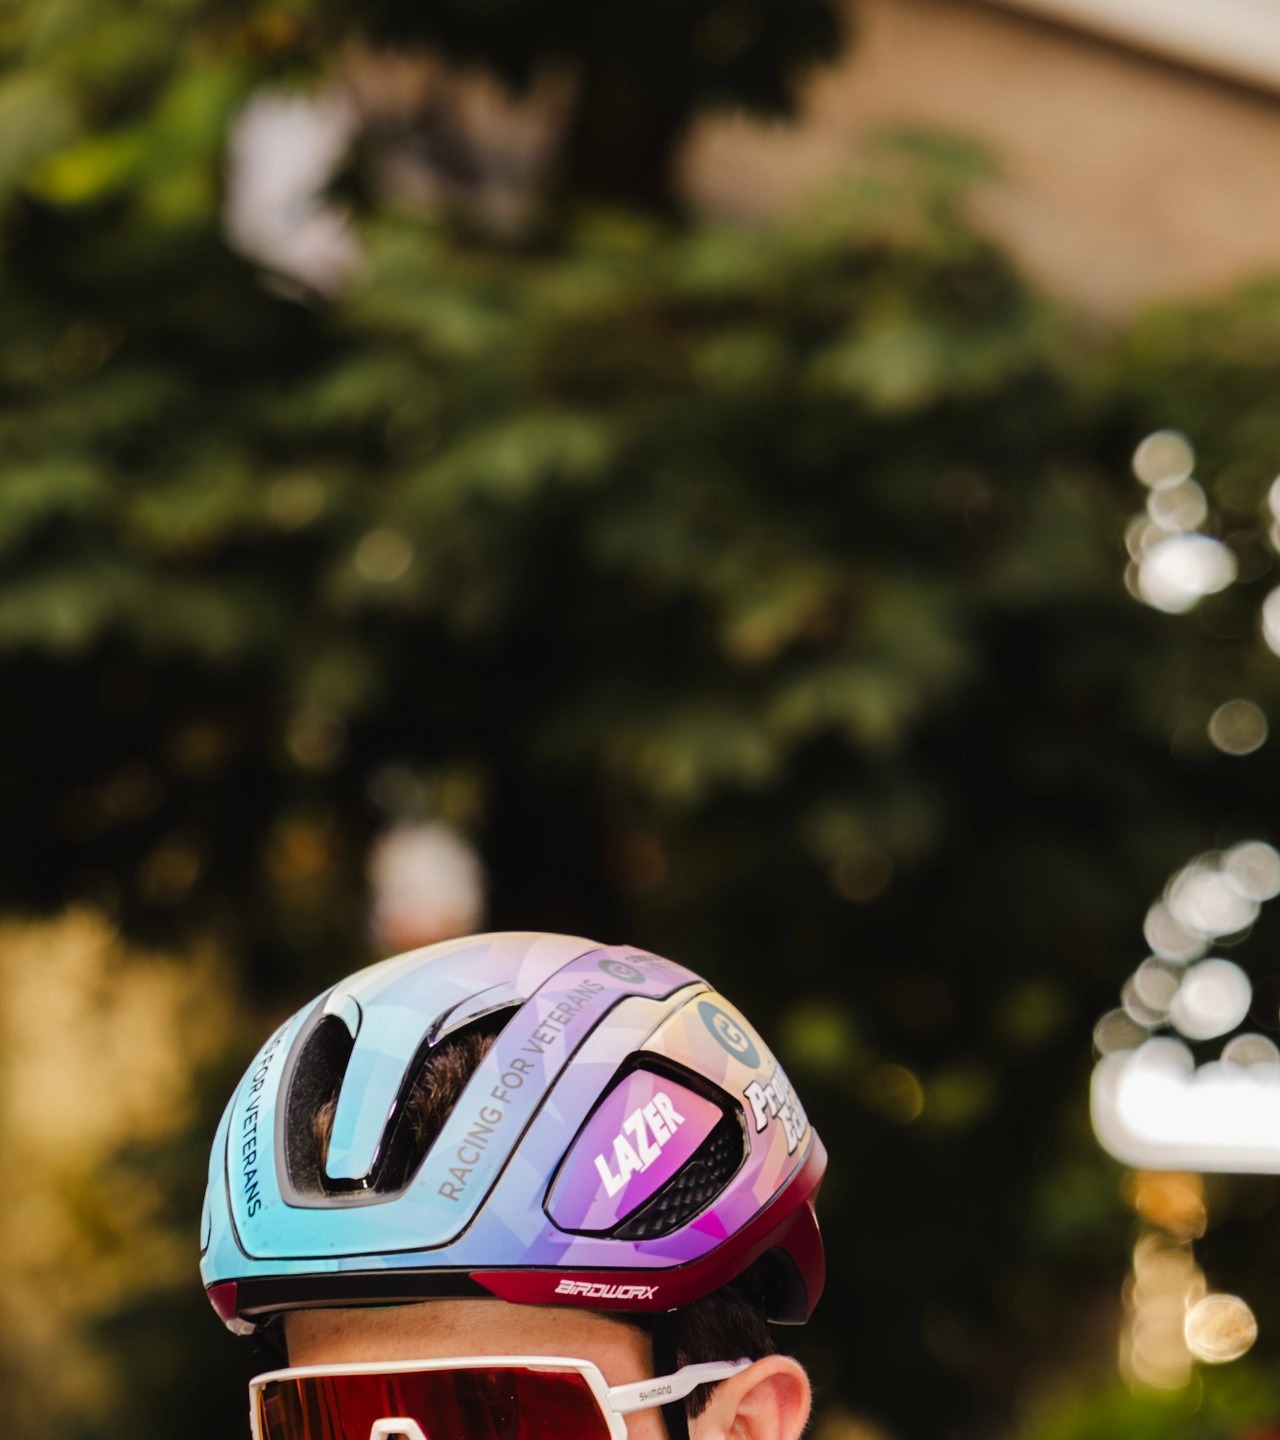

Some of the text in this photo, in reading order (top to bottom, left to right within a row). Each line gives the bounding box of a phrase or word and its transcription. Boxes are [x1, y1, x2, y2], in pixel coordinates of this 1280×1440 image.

[251, 1054, 274, 1097] FOR
[438, 979, 605, 1201] RACING FOR VETERANS
[242, 1095, 264, 1218] VETERANS
[594, 1091, 685, 1198] LAZER
[639, 1385, 672, 1401] SHIMANO
